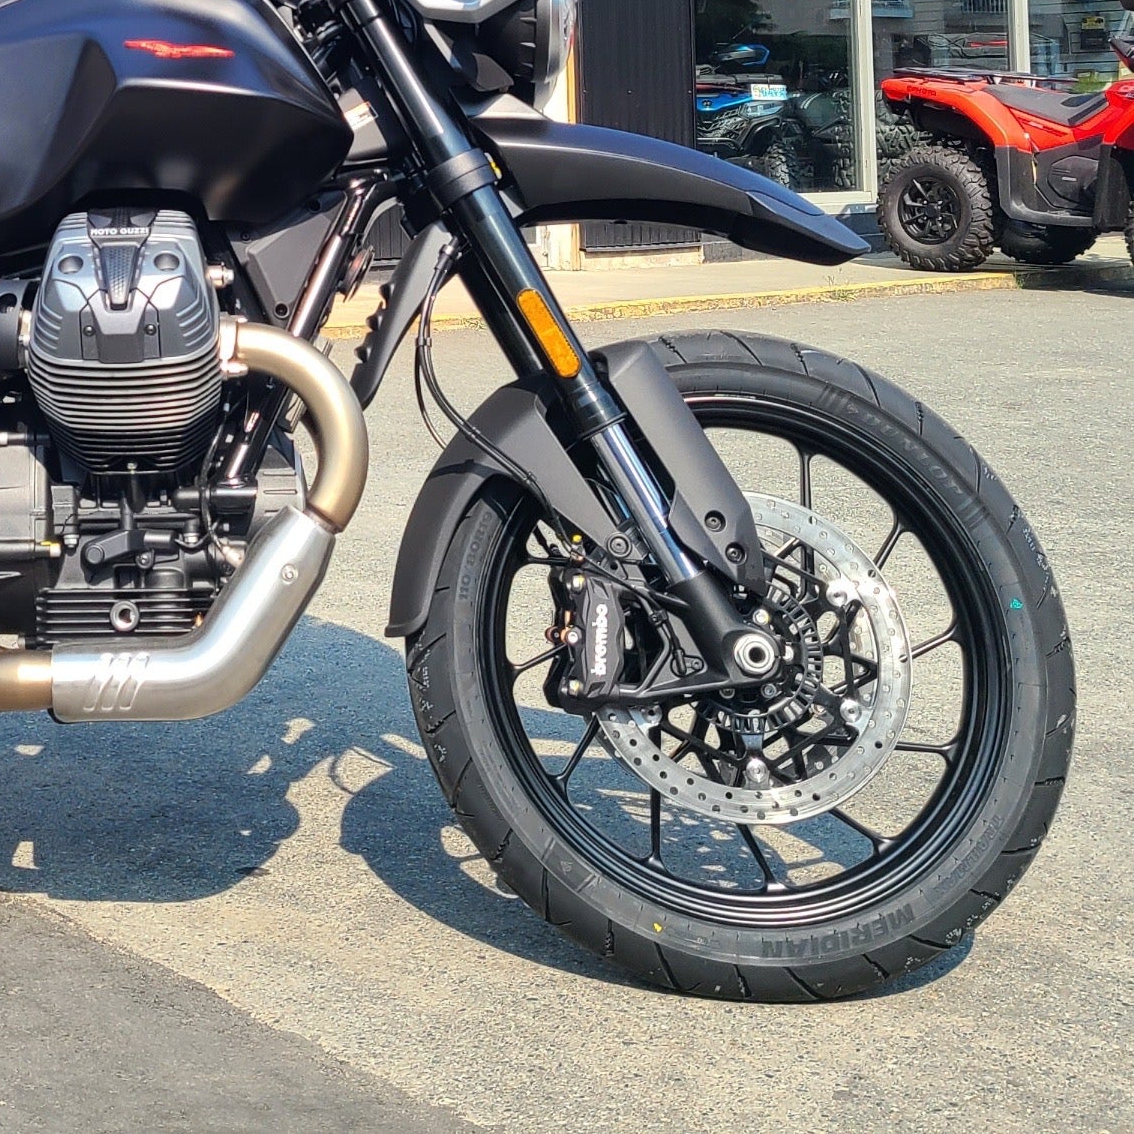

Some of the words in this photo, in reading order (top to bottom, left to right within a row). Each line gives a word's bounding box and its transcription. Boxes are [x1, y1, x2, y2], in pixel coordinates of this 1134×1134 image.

[90, 227, 118, 236] MOTO
[119, 226, 150, 235] GUZZI
[590, 603, 609, 677] brembo
[761, 902, 917, 960] MERIDIAN
